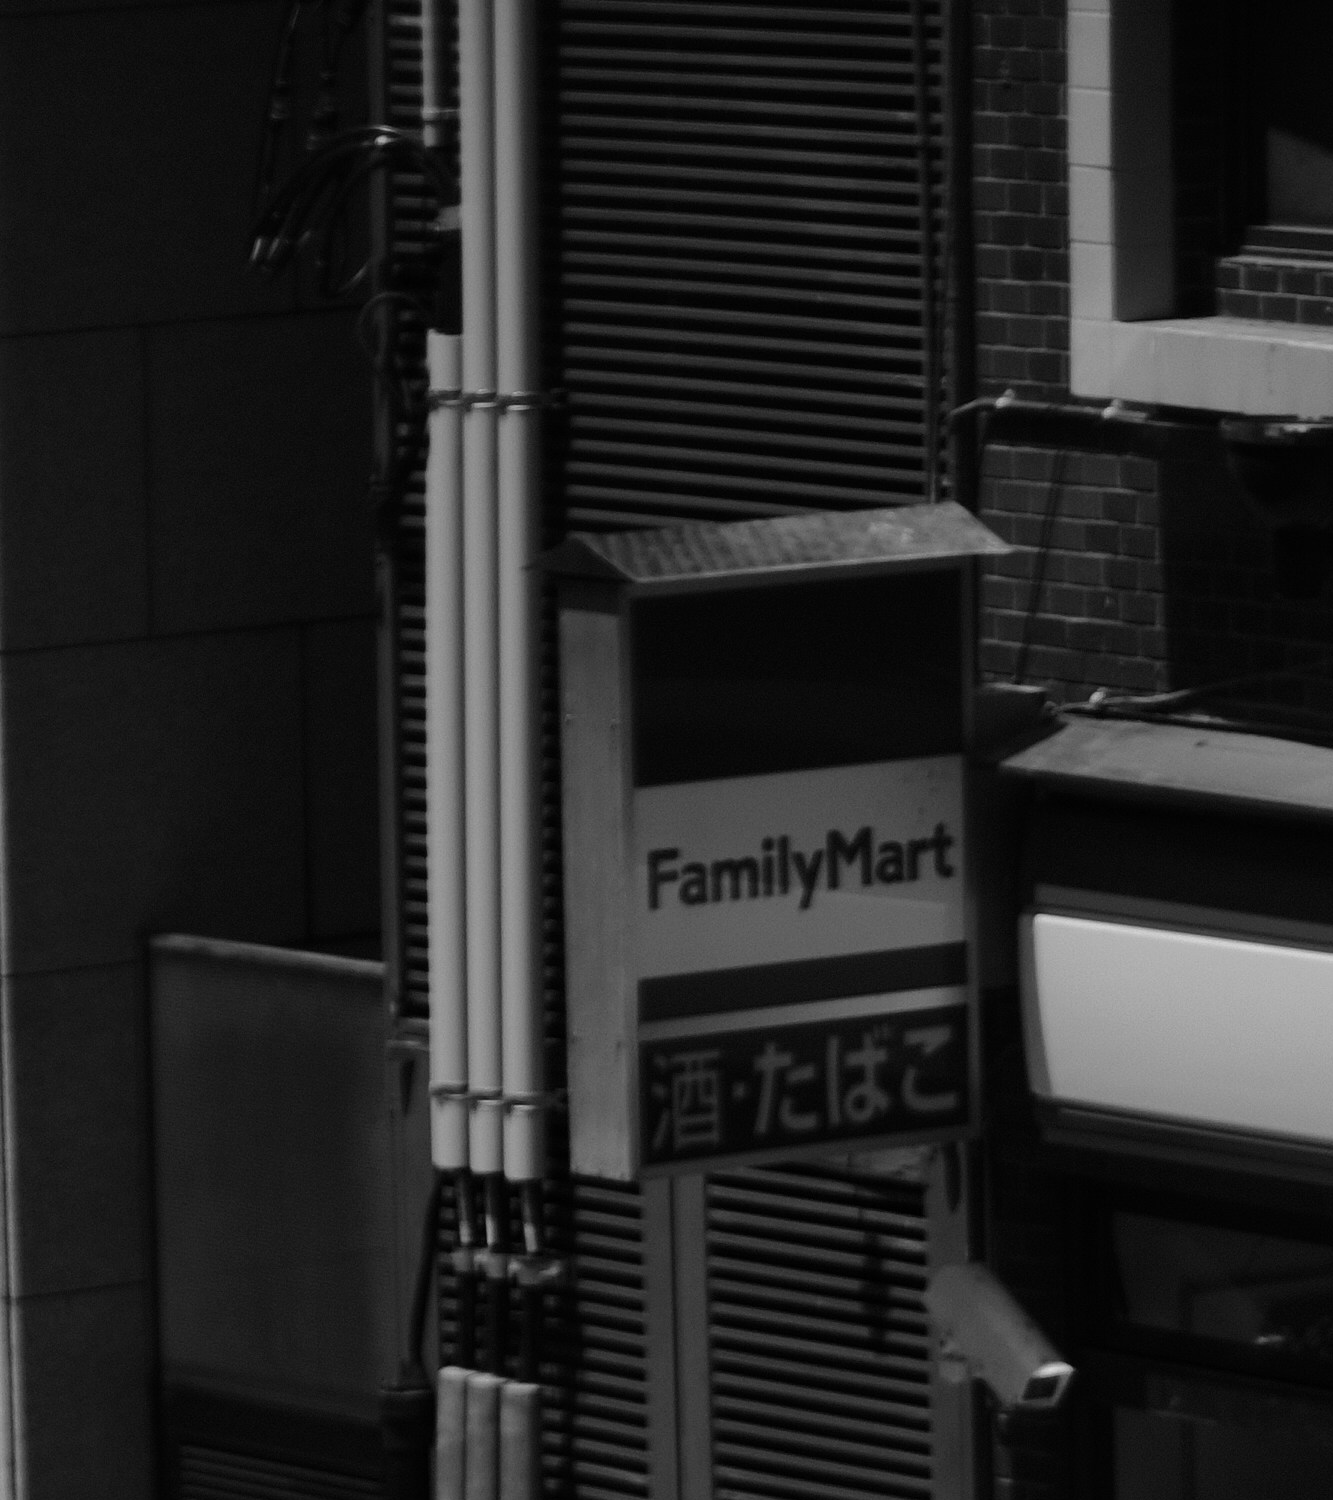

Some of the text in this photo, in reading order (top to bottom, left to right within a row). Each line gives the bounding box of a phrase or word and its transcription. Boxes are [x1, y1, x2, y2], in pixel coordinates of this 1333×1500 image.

[647, 821, 955, 911] FamilyMart
[652, 1023, 957, 1149] 酒・たばこ
